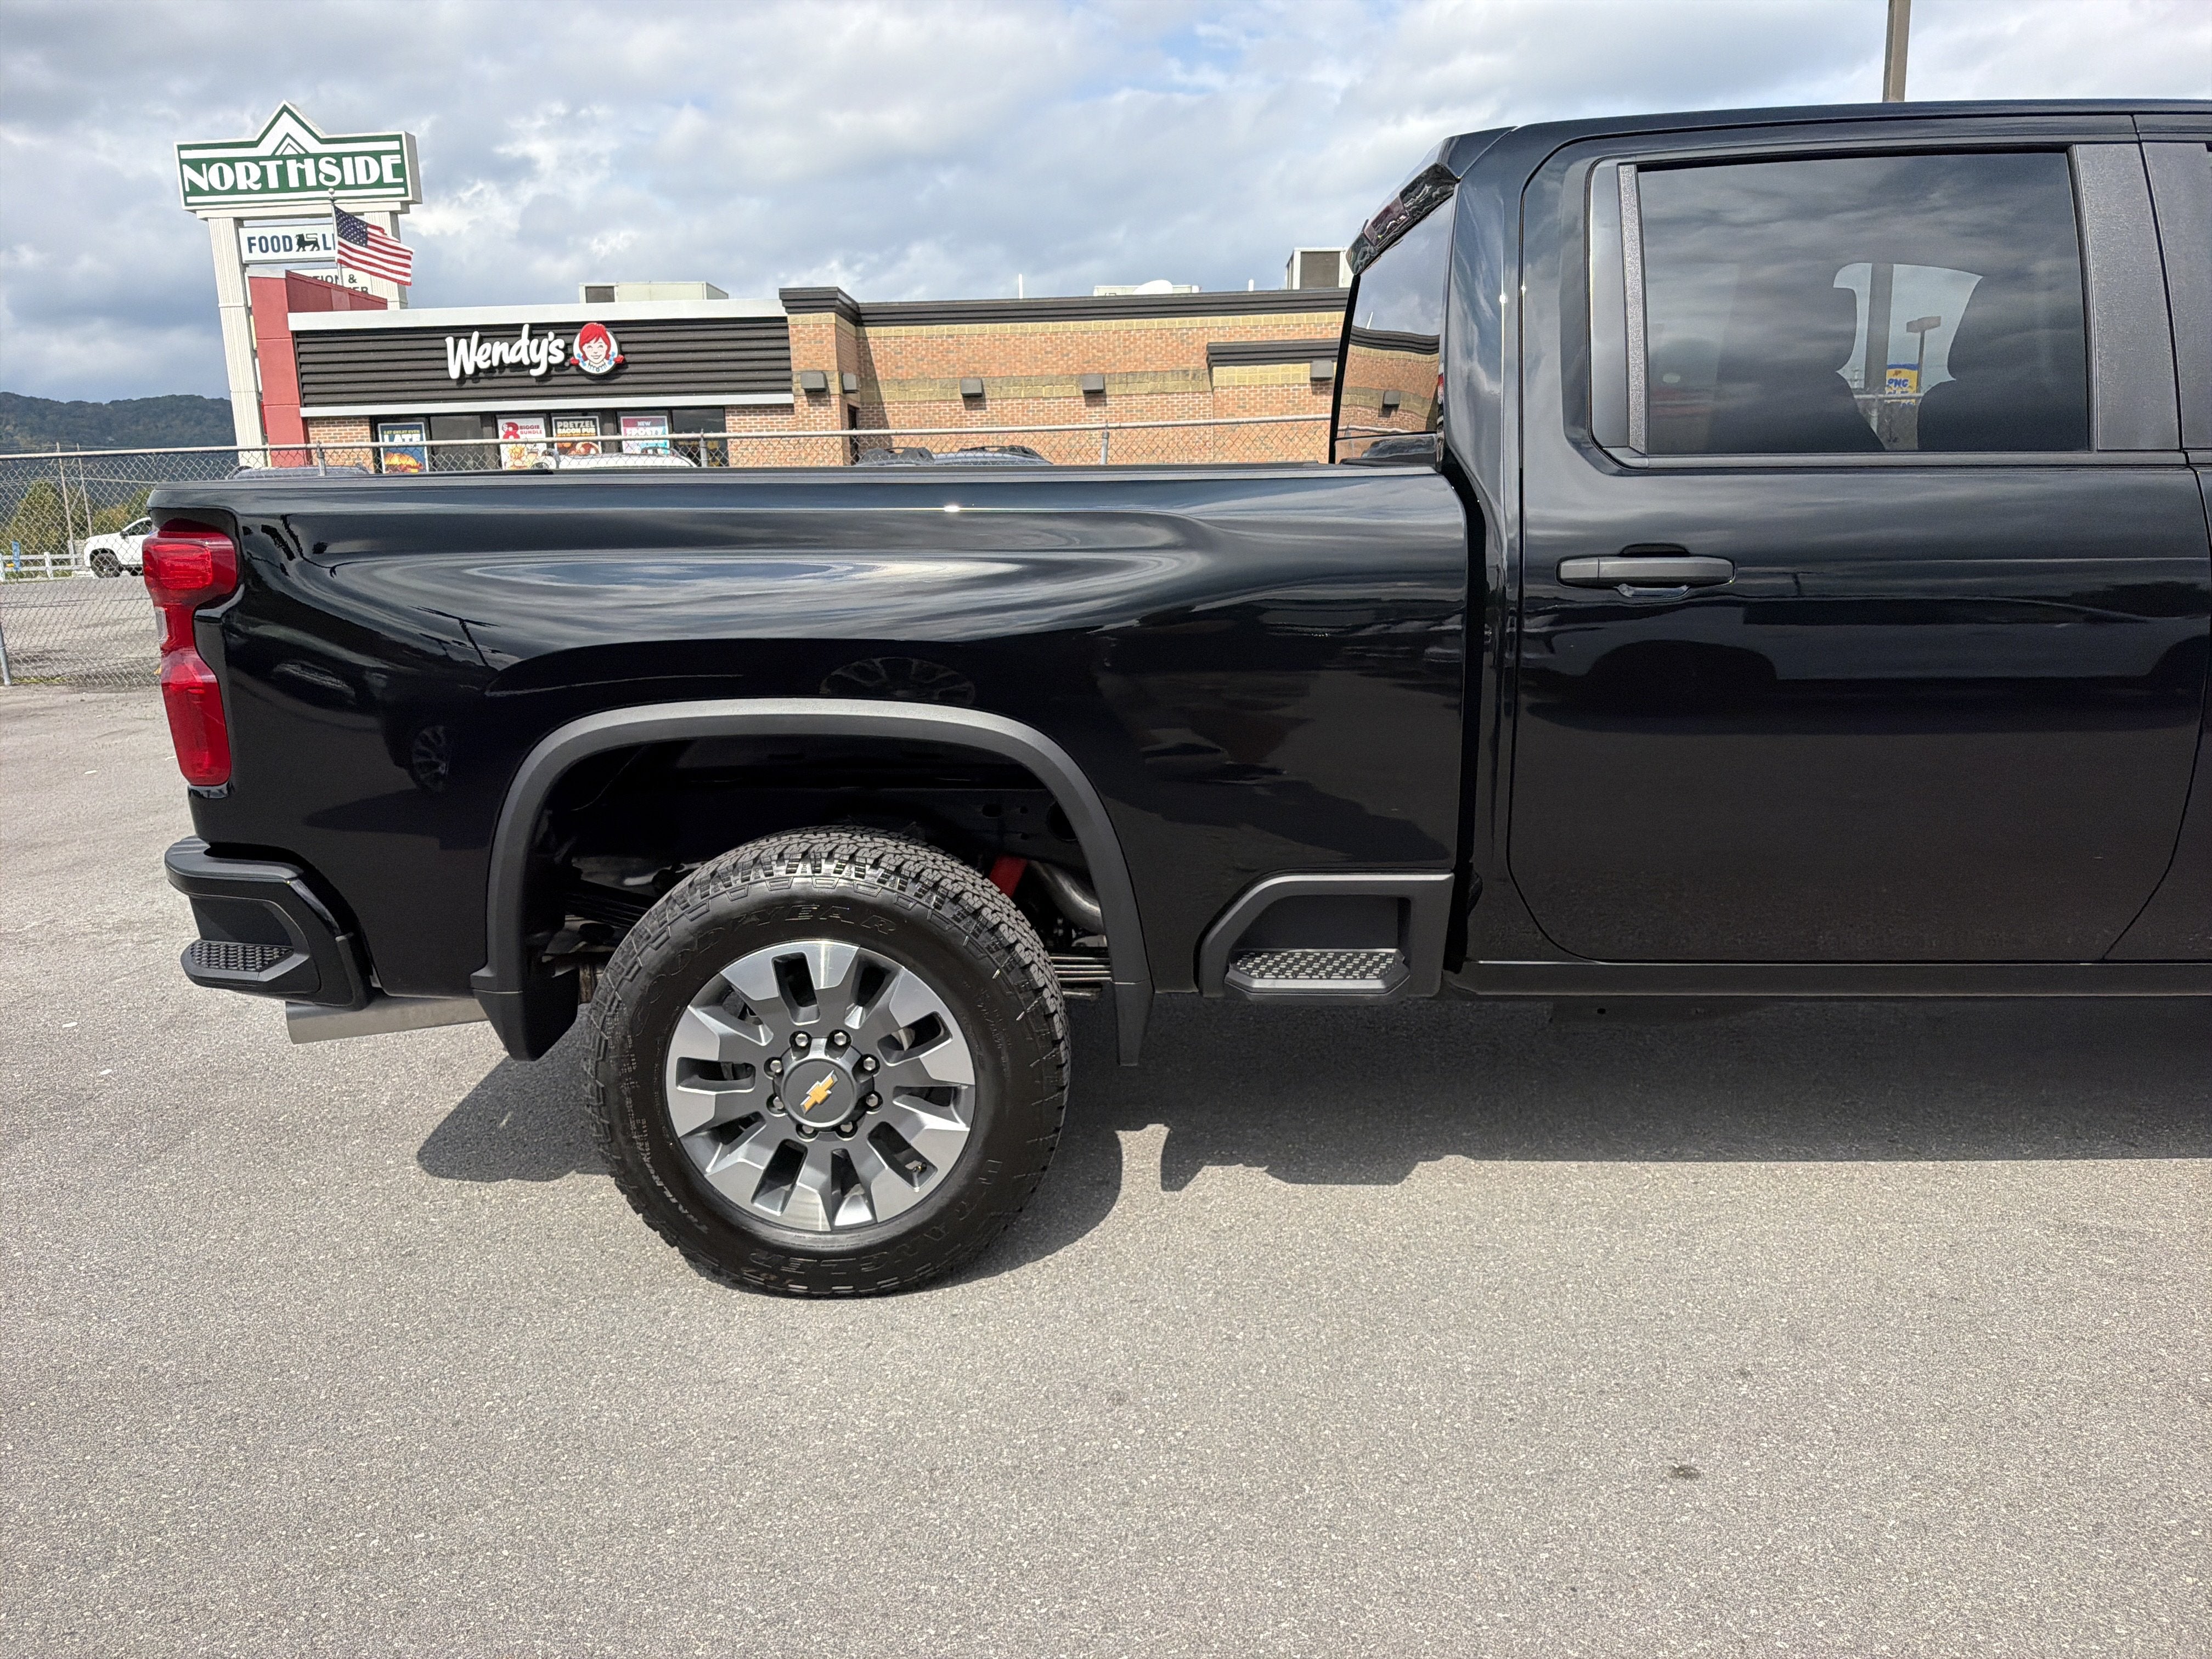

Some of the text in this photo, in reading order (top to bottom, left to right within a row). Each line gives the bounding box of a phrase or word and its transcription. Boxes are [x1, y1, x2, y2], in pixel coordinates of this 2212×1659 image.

[182, 154, 404, 191] NORTHSIDE
[247, 235, 293, 253] FOOD
[445, 324, 565, 379] Wendy's
[556, 420, 595, 428] PRETZEL
